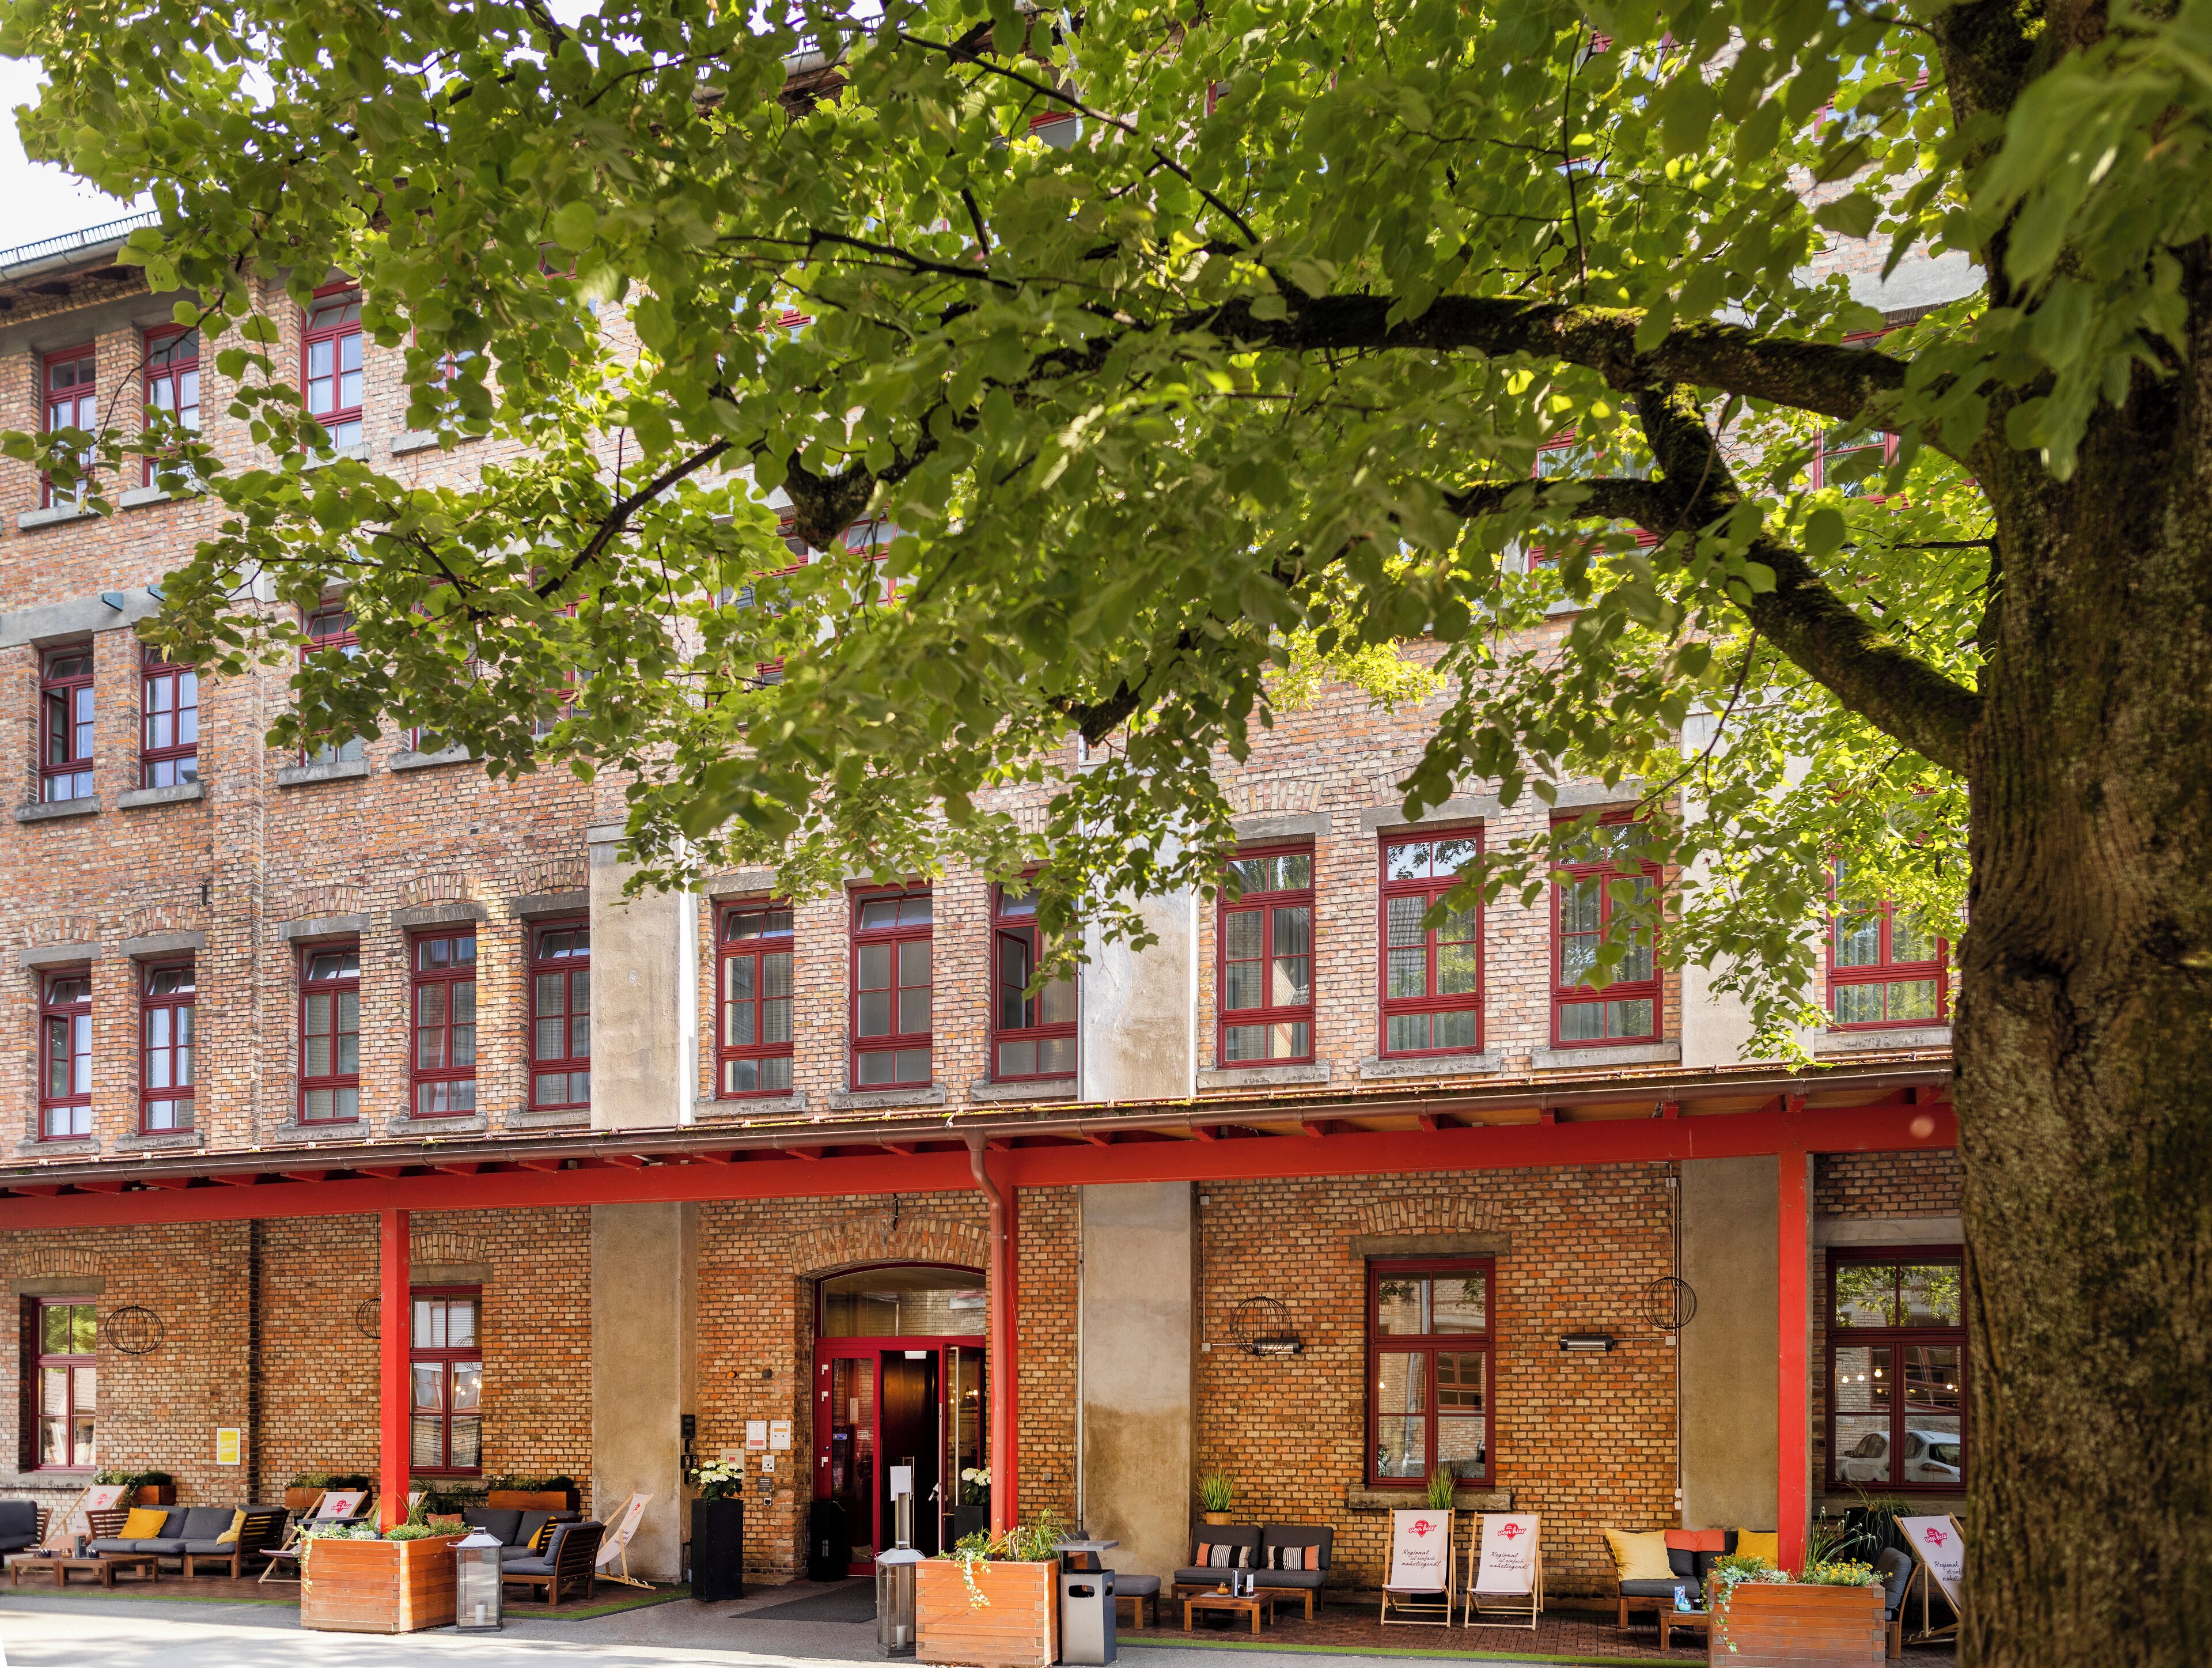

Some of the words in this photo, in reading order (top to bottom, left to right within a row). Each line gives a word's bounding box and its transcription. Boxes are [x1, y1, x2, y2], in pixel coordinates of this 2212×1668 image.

[1423, 1523, 1437, 1531] hier
[1512, 1526, 1527, 1534] hier
[1925, 1535, 1936, 1544] von
[1935, 1531, 1947, 1541] hier
[1402, 1549, 1430, 1558] Regional
[1490, 1551, 1518, 1560] Regional
[1401, 1560, 1441, 1569] naheliegend!
[1489, 1563, 1530, 1572] naheliegend!
[1933, 1560, 1959, 1571] Regional
